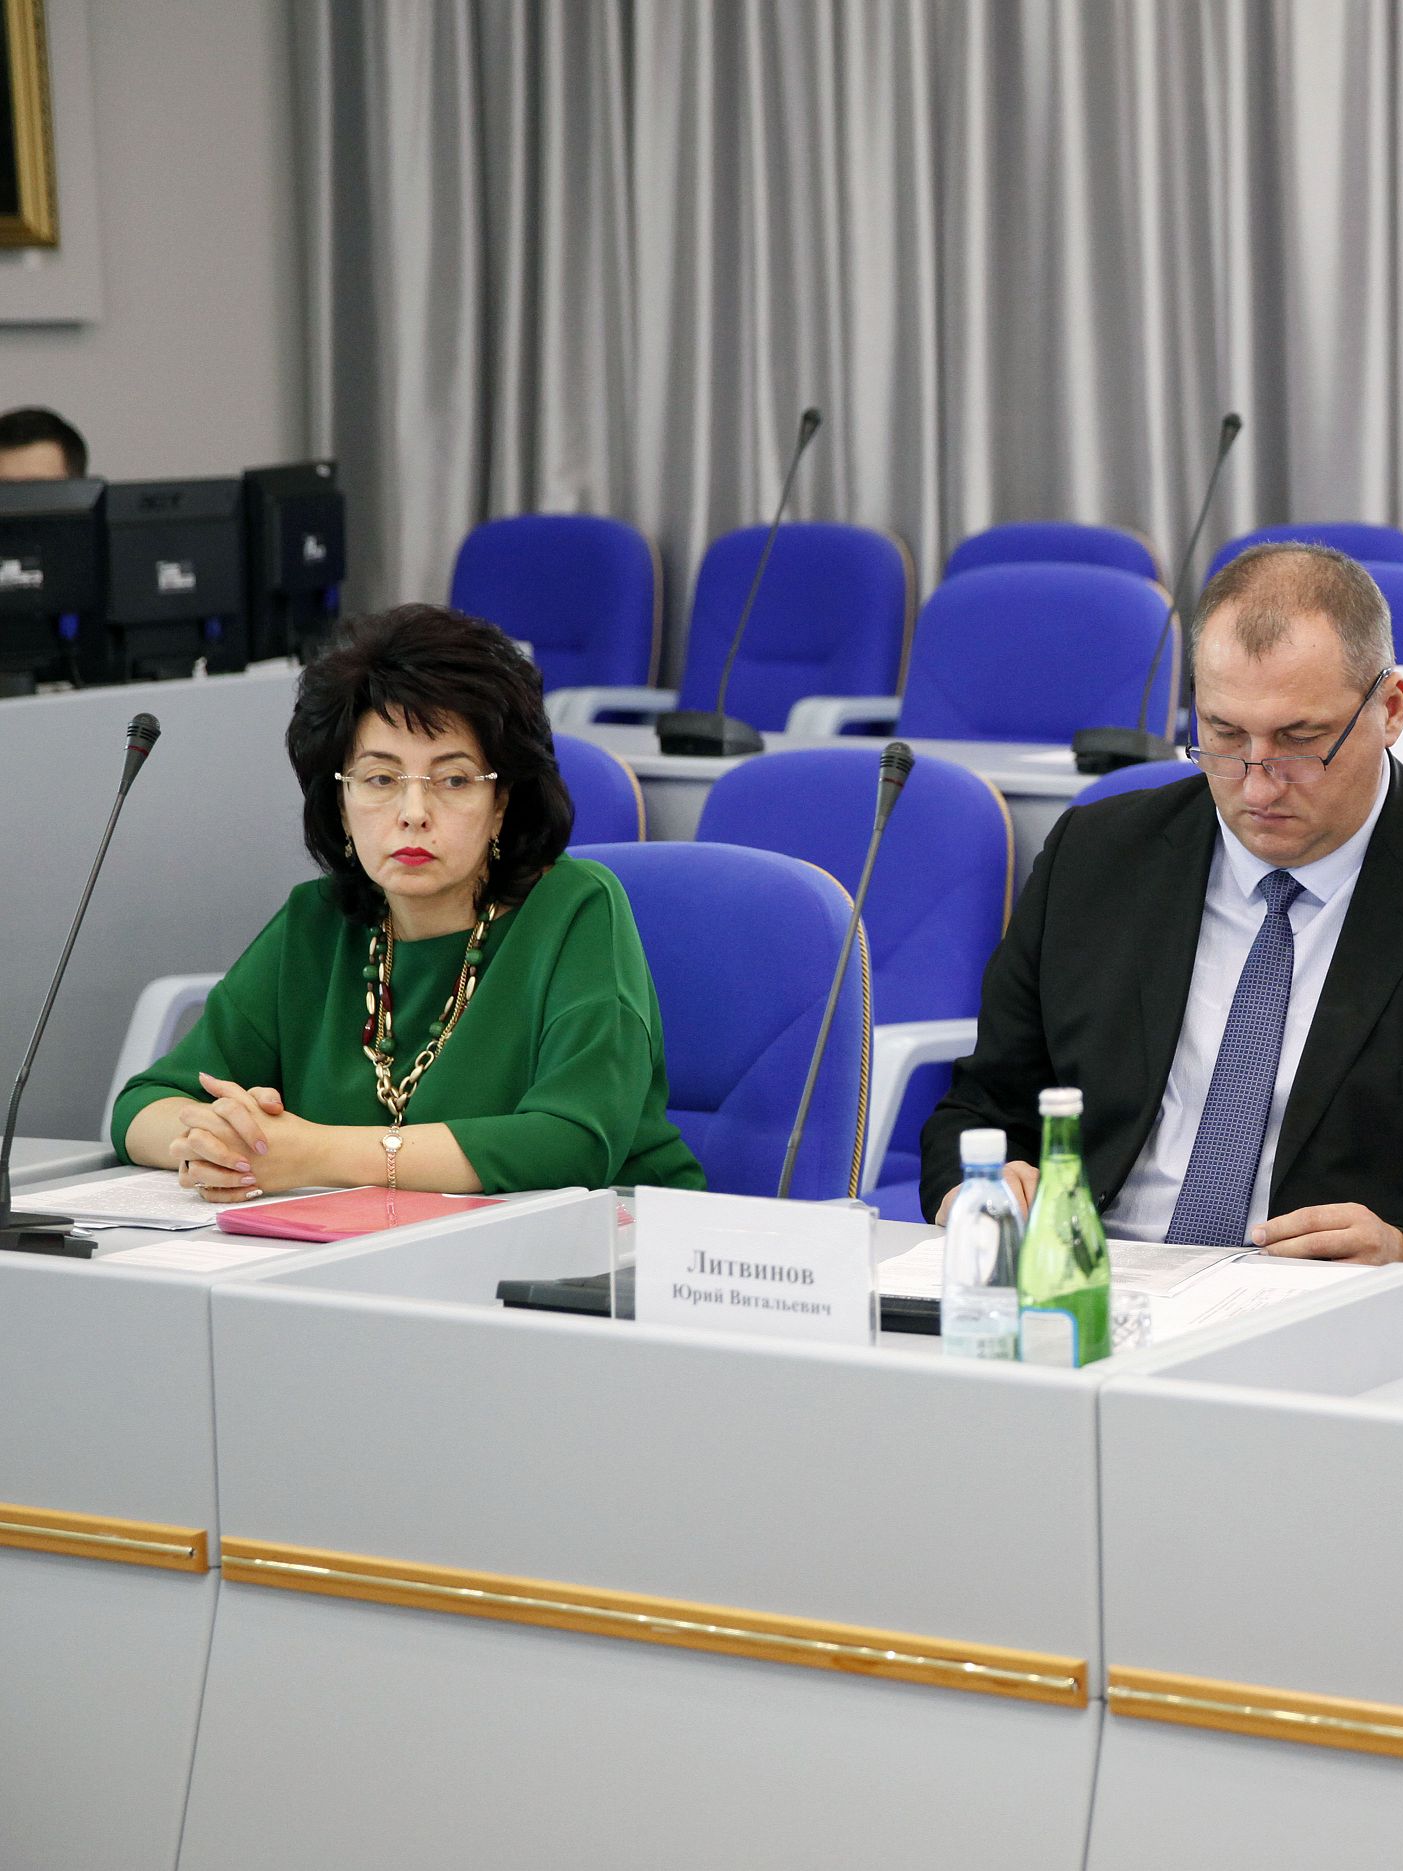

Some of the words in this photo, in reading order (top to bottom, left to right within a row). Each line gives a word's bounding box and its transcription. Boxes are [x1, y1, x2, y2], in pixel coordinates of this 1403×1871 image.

[688, 1250, 815, 1285] Литвинов
[672, 1282, 724, 1304] Юрий
[730, 1290, 831, 1316] Витальевич
